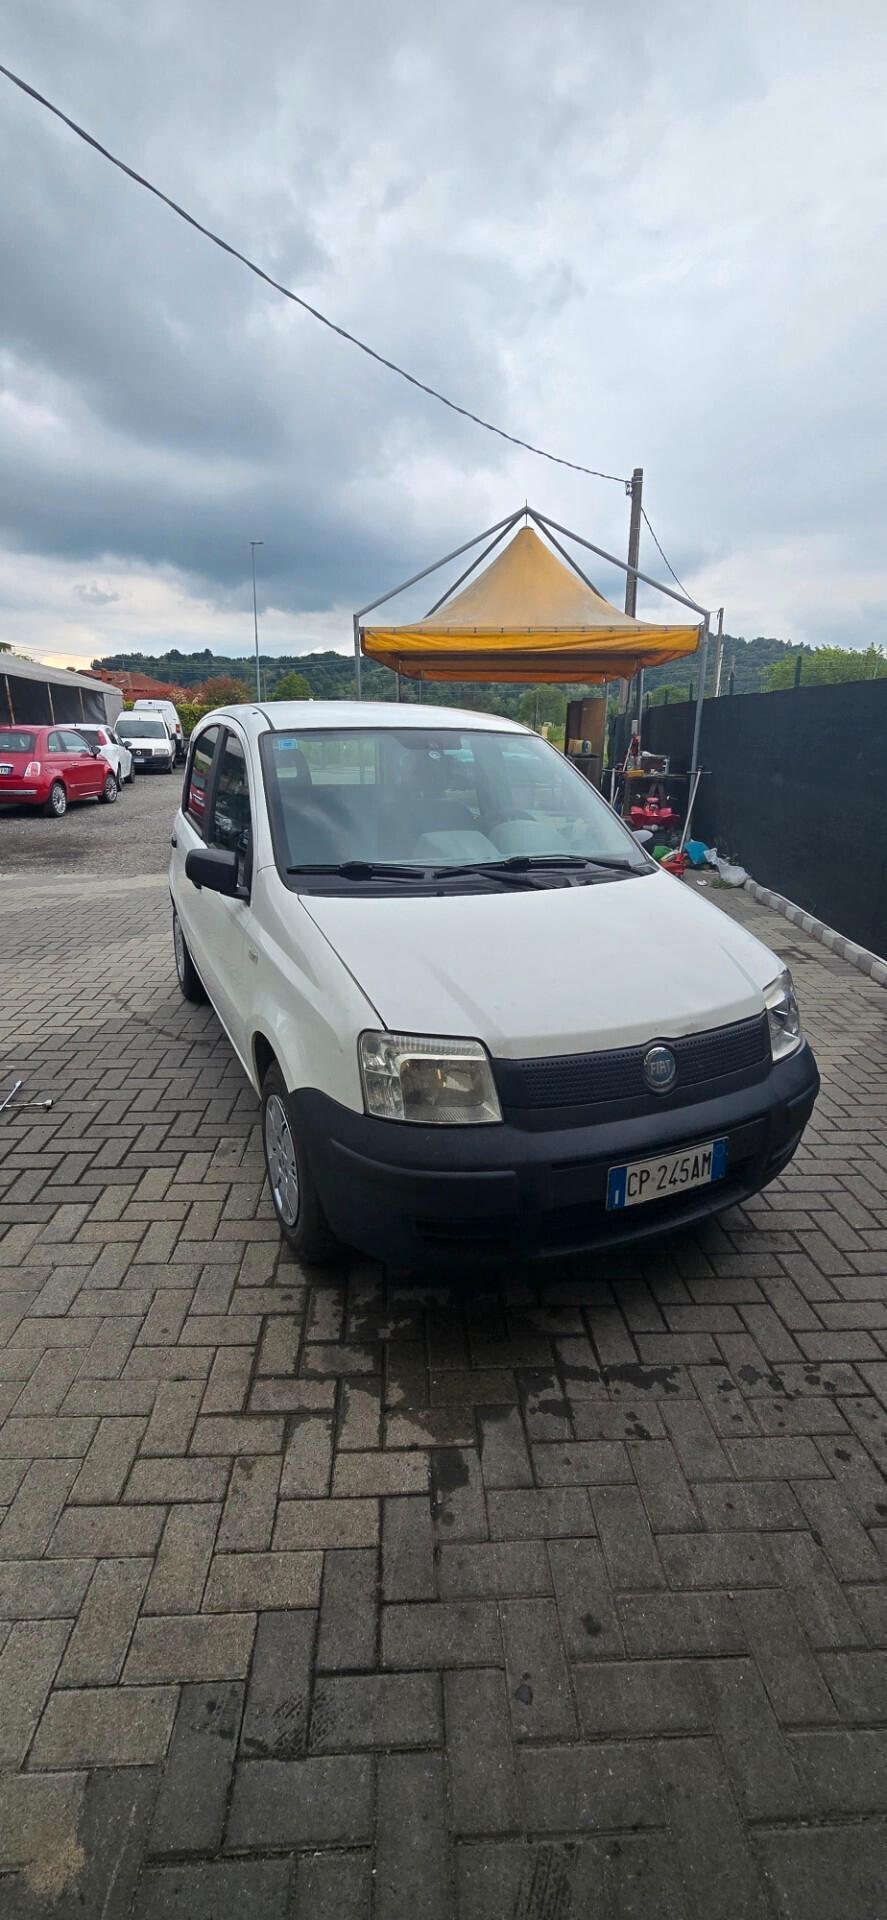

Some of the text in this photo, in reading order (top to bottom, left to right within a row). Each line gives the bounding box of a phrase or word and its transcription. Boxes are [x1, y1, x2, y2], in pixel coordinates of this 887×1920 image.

[651, 1060, 671, 1075] FIAT
[627, 1151, 712, 1197] CP 245AM
